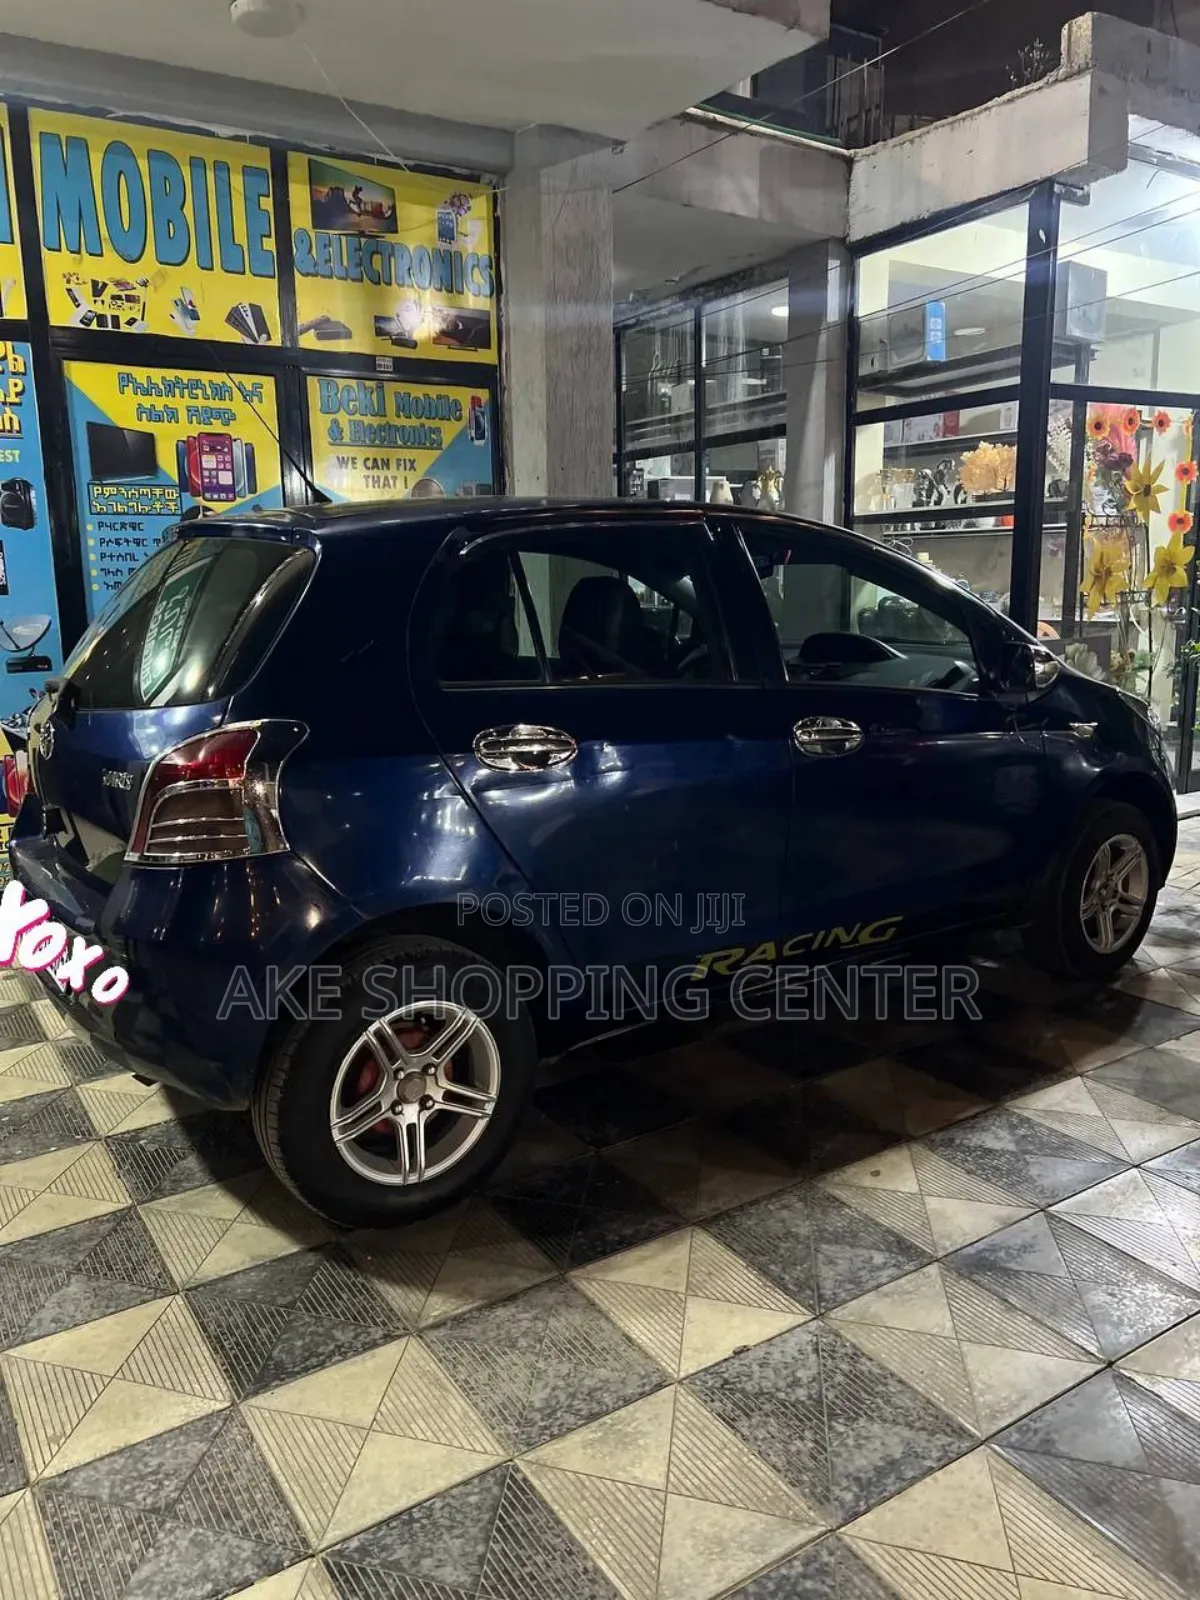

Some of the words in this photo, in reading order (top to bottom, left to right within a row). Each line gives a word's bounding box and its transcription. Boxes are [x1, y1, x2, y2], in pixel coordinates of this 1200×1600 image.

[39, 131, 276, 279] MOBILE
[293, 227, 495, 299] &ELECTRONICS
[317, 378, 387, 418] Beki
[394, 391, 464, 421] Mobile
[327, 418, 344, 442] &
[348, 419, 444, 447] Electronics
[336, 456, 358, 470] WE
[363, 456, 391, 471] CAN
[396, 457, 417, 472] FIX
[363, 474, 398, 489] THAT
[690, 916, 903, 981] RACING
